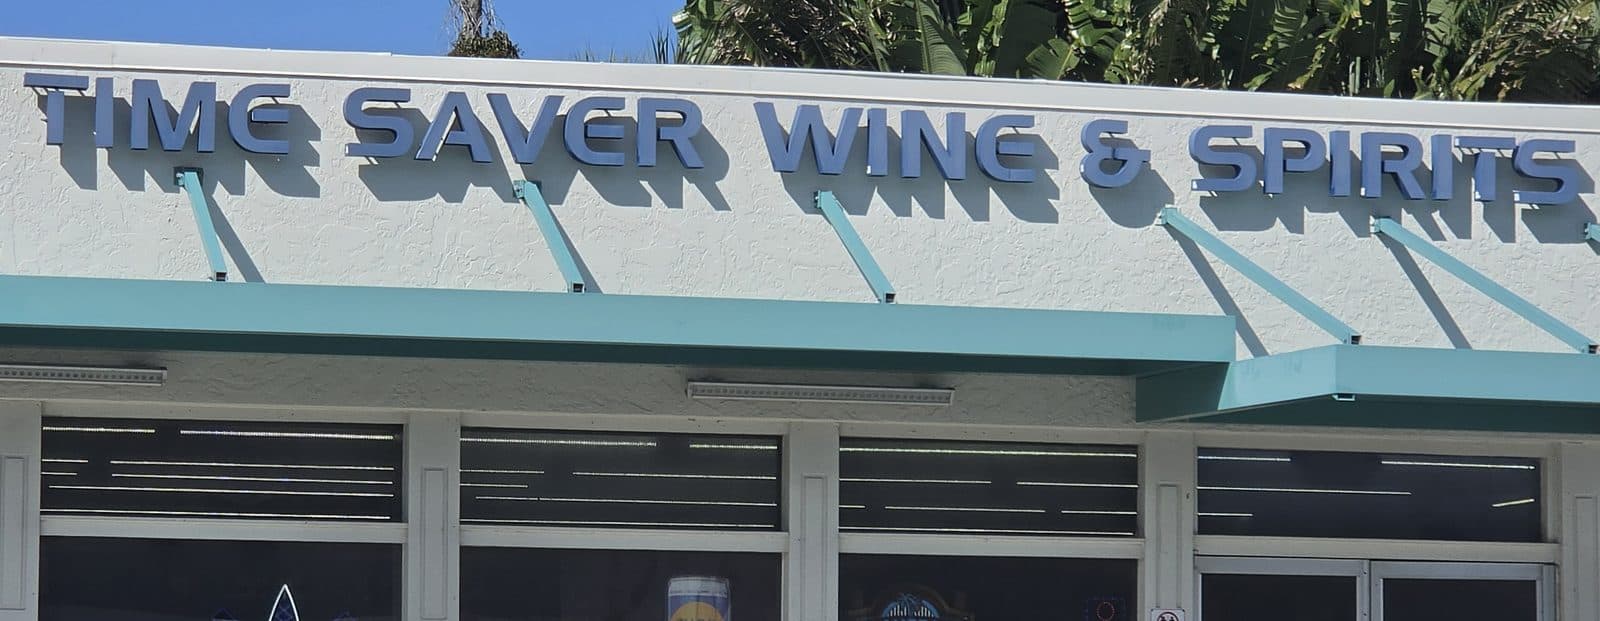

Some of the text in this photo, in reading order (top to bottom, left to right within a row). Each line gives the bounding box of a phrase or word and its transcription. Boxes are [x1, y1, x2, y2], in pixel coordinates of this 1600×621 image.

[24, 73, 1577, 206] TIME SAVER WINE & SPIRITS
